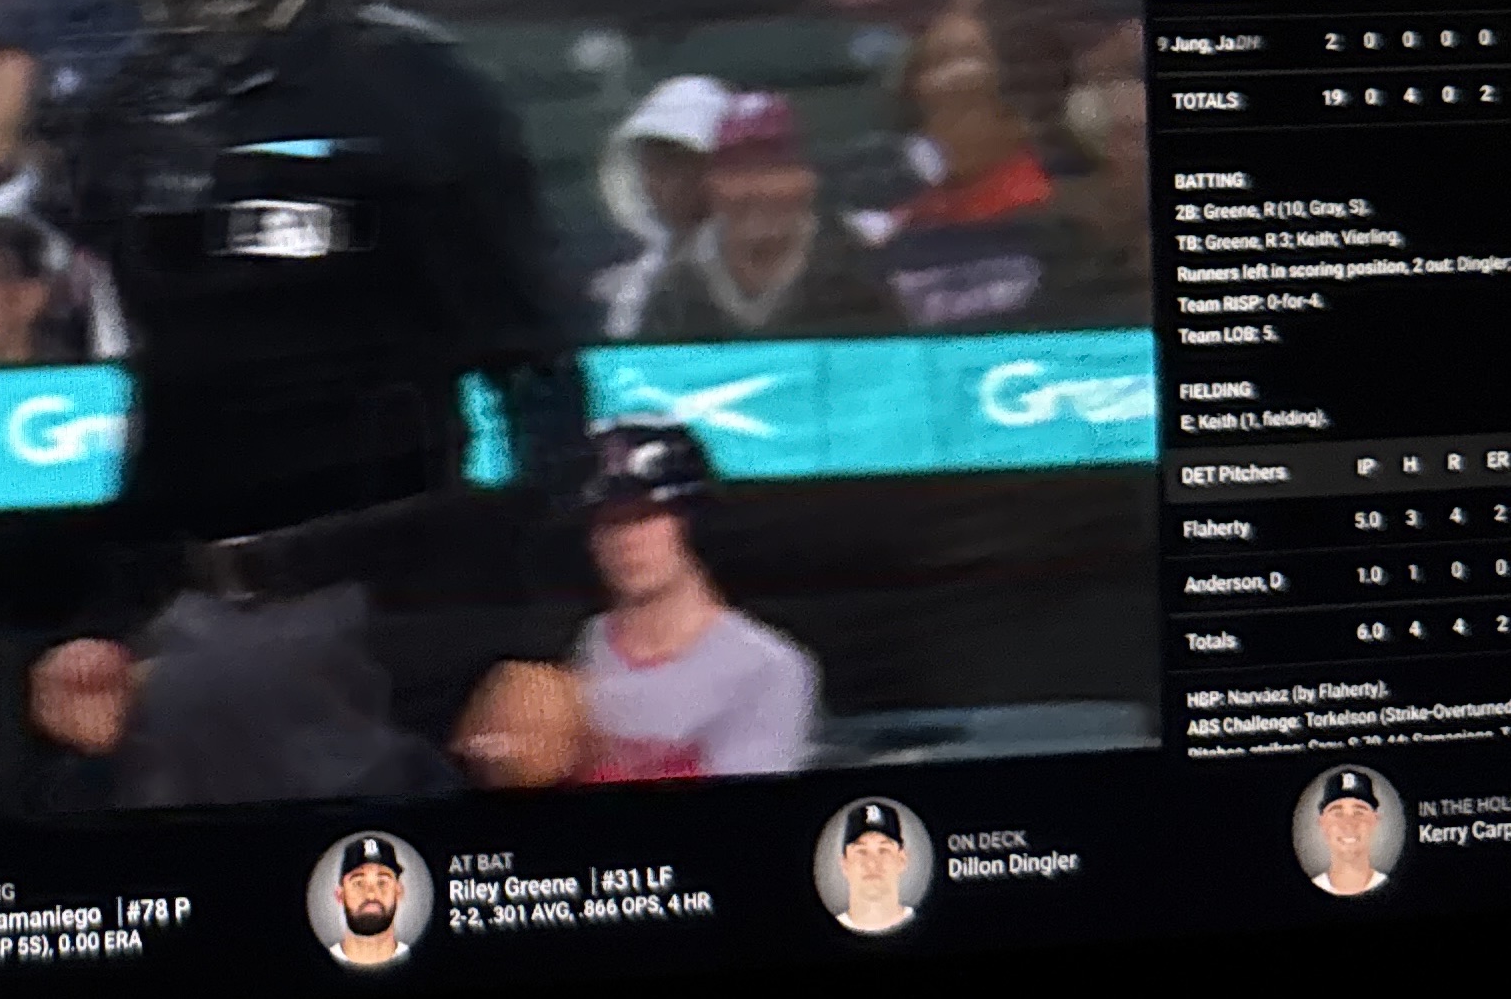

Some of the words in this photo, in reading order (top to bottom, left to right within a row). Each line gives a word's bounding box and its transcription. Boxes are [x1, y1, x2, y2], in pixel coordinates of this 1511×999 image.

[1173, 92, 1241, 109] TOTALS
[1175, 172, 1246, 189] BATTING
[1178, 297, 1221, 313] Team
[1178, 328, 1222, 343] Team
[1180, 381, 1254, 399] FIELDING
[1182, 466, 1216, 484] DET
[1219, 464, 1288, 482] Pitchers
[1184, 519, 1250, 538] Flaherty
[1186, 631, 1238, 650] Totals
[1187, 718, 1221, 736] ABS
[1305, 710, 1377, 727] Torkelson
[1419, 802, 1437, 816] IN
[1441, 798, 1474, 815] THE
[948, 834, 975, 851] ON
[979, 831, 1026, 849] DECK
[1420, 824, 1468, 845] Kerry
[449, 855, 472, 873] AT
[478, 853, 513, 872] BAT
[949, 857, 1005, 878] Dillon
[1009, 851, 1077, 876] Dingler
[450, 879, 499, 906] Riley
[505, 877, 578, 902] Greene
[601, 869, 640, 891] #31
[647, 866, 672, 889] LF
[127, 899, 169, 922] #78
[175, 897, 190, 919] P
[668, 894, 681, 912] 4
[684, 892, 711, 910] HR
[59, 932, 99, 953] 0.00
[105, 929, 142, 951] ERA
